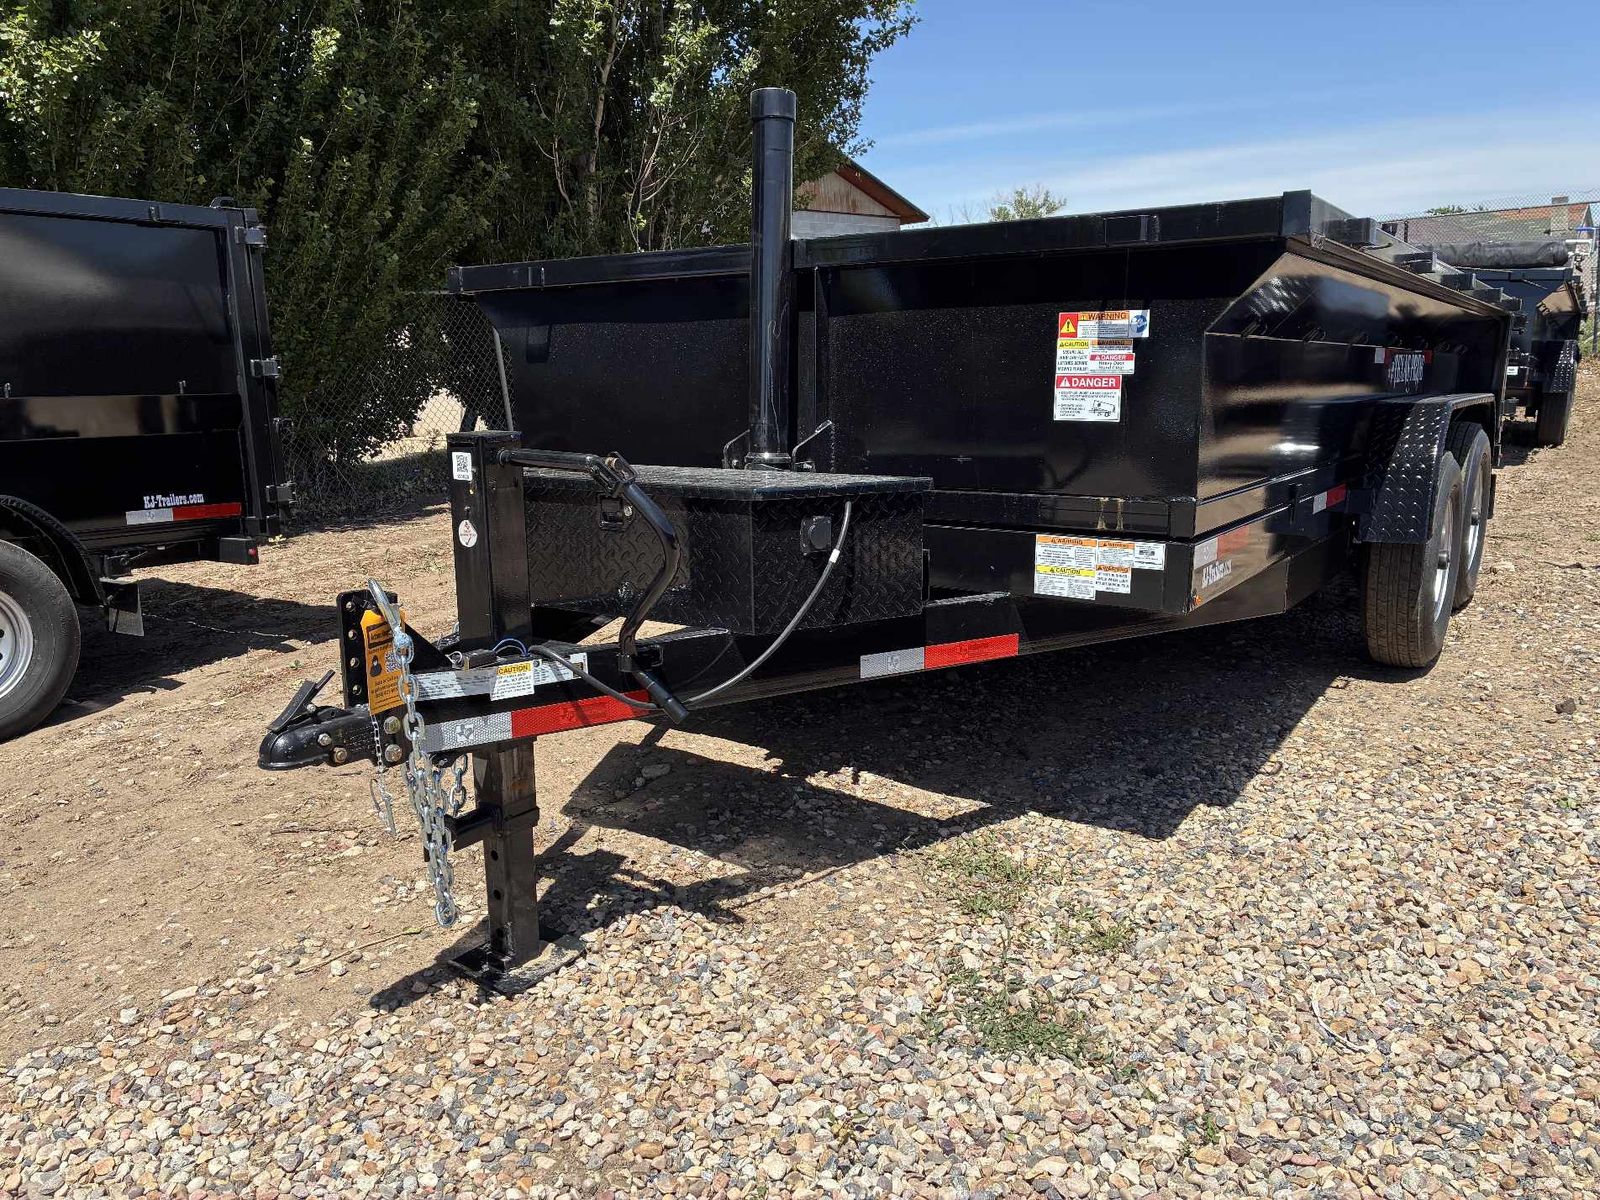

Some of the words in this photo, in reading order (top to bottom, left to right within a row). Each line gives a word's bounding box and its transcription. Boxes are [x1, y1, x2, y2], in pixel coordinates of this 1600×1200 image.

[1088, 312, 1127, 321] WARNING
[1071, 377, 1116, 388] DANGER
[143, 493, 205, 509] KJ-Trailers.com
[1055, 567, 1081, 575] CAUTION
[498, 664, 530, 675] CAUTION
